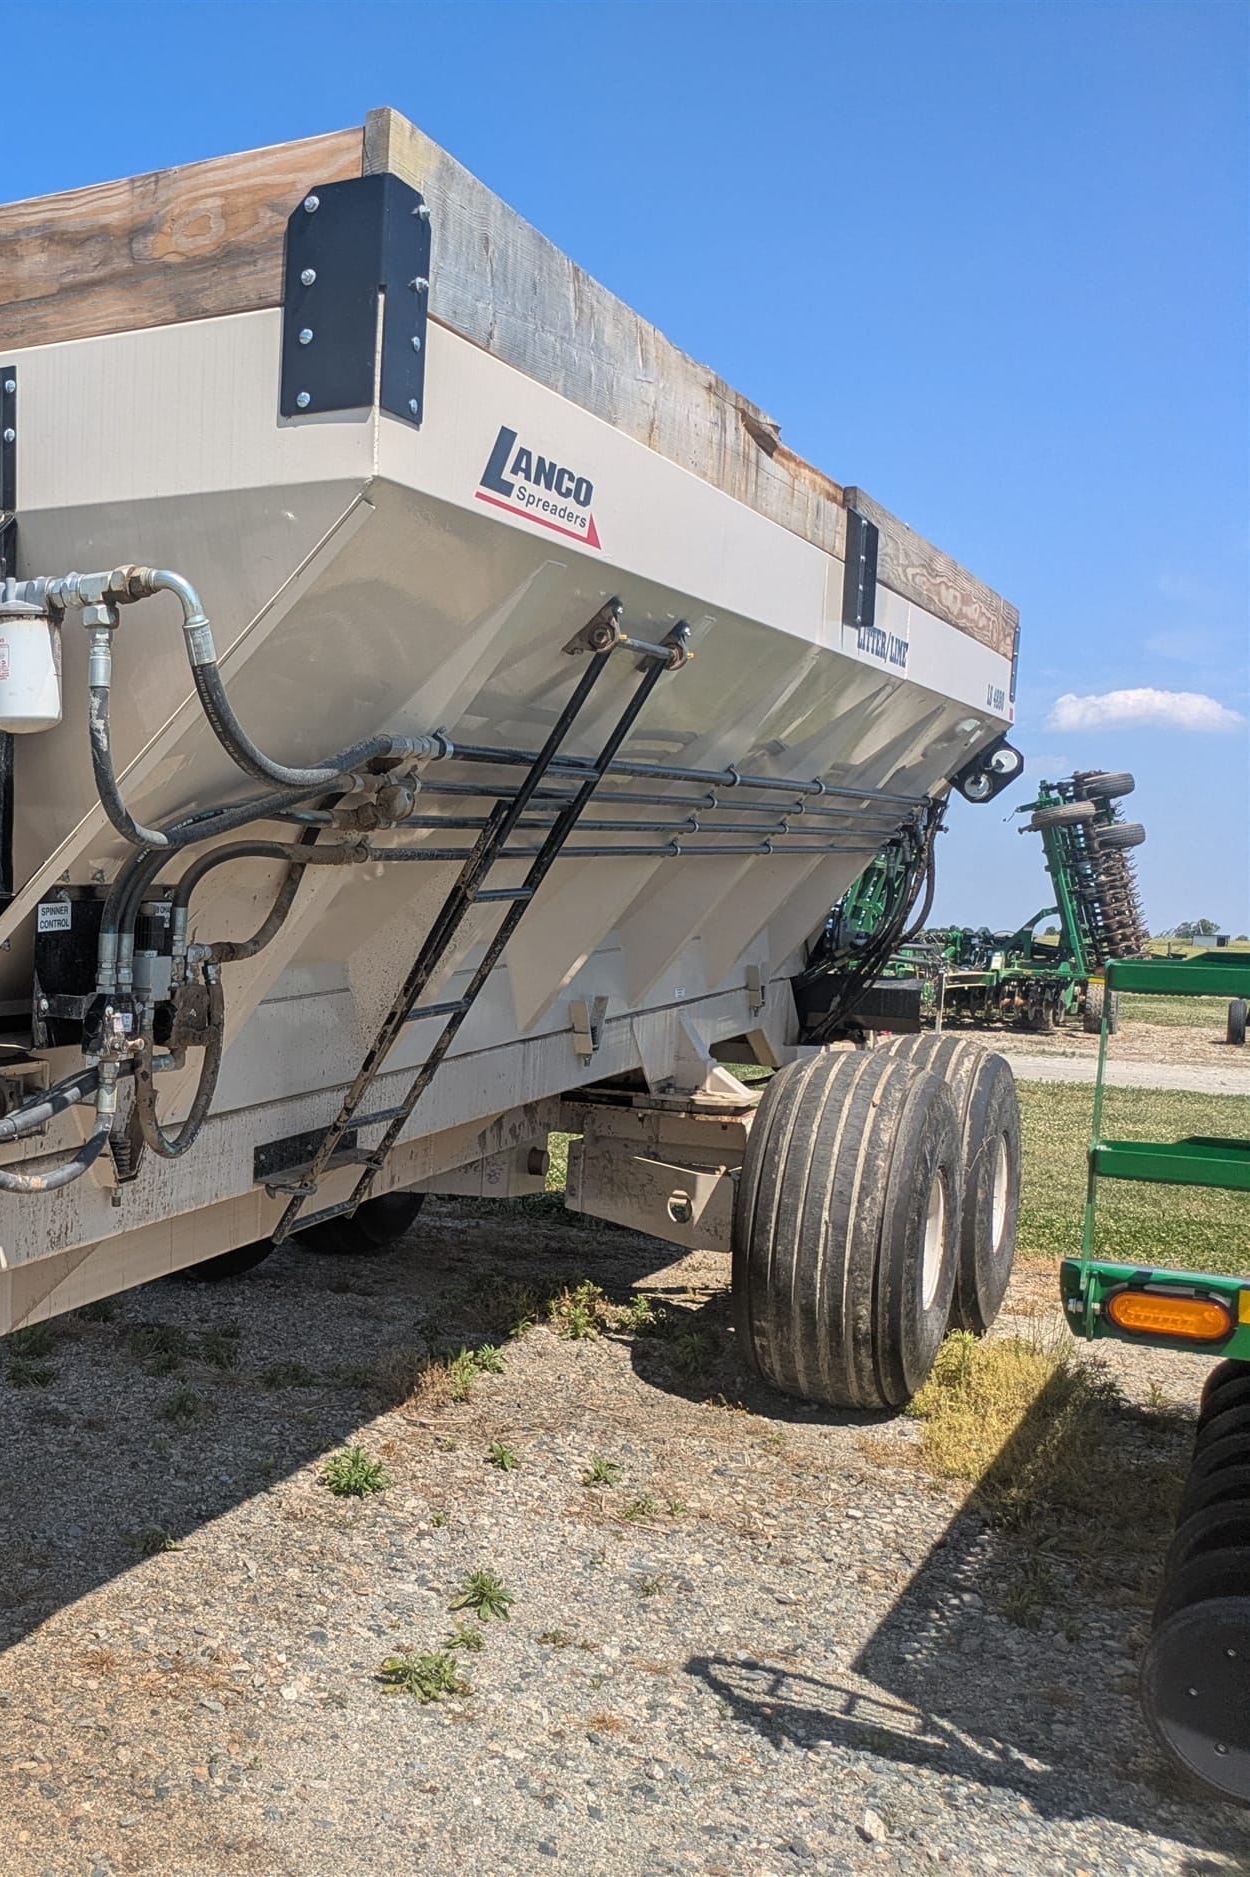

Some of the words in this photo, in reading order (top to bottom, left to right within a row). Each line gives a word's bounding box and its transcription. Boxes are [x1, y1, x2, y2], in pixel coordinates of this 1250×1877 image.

[479, 425, 593, 508] LANCO
[516, 486, 587, 528] Spreaders
[40, 919, 69, 929] CONTROL
[41, 906, 69, 916] SPINNER
